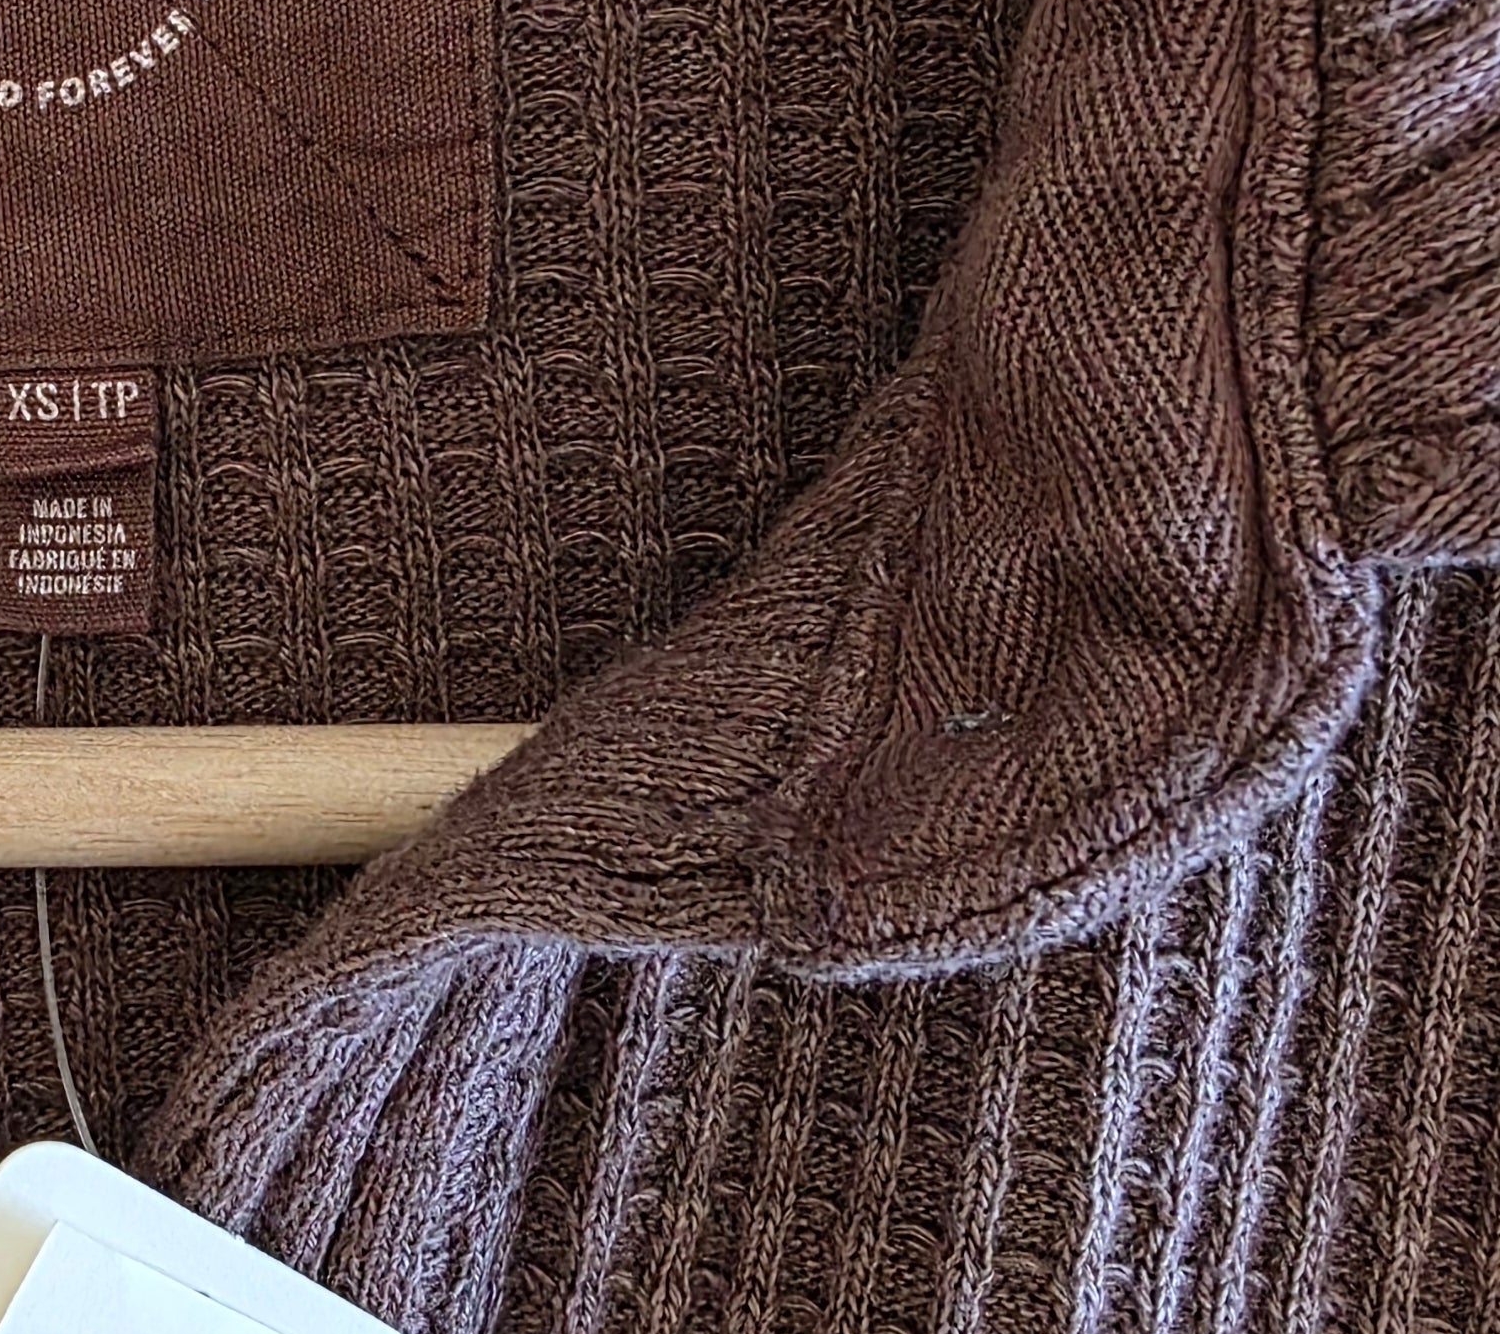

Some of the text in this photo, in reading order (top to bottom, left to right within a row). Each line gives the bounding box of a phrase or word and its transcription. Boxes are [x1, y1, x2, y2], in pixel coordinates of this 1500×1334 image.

[36, 8, 199, 110] FOREVER
[32, 497, 113, 519] MADE IN
[18, 523, 127, 546] INDONESIA
[8, 546, 137, 573] FABRIQUÉ EN
[17, 573, 125, 596] INDONÉSIE
